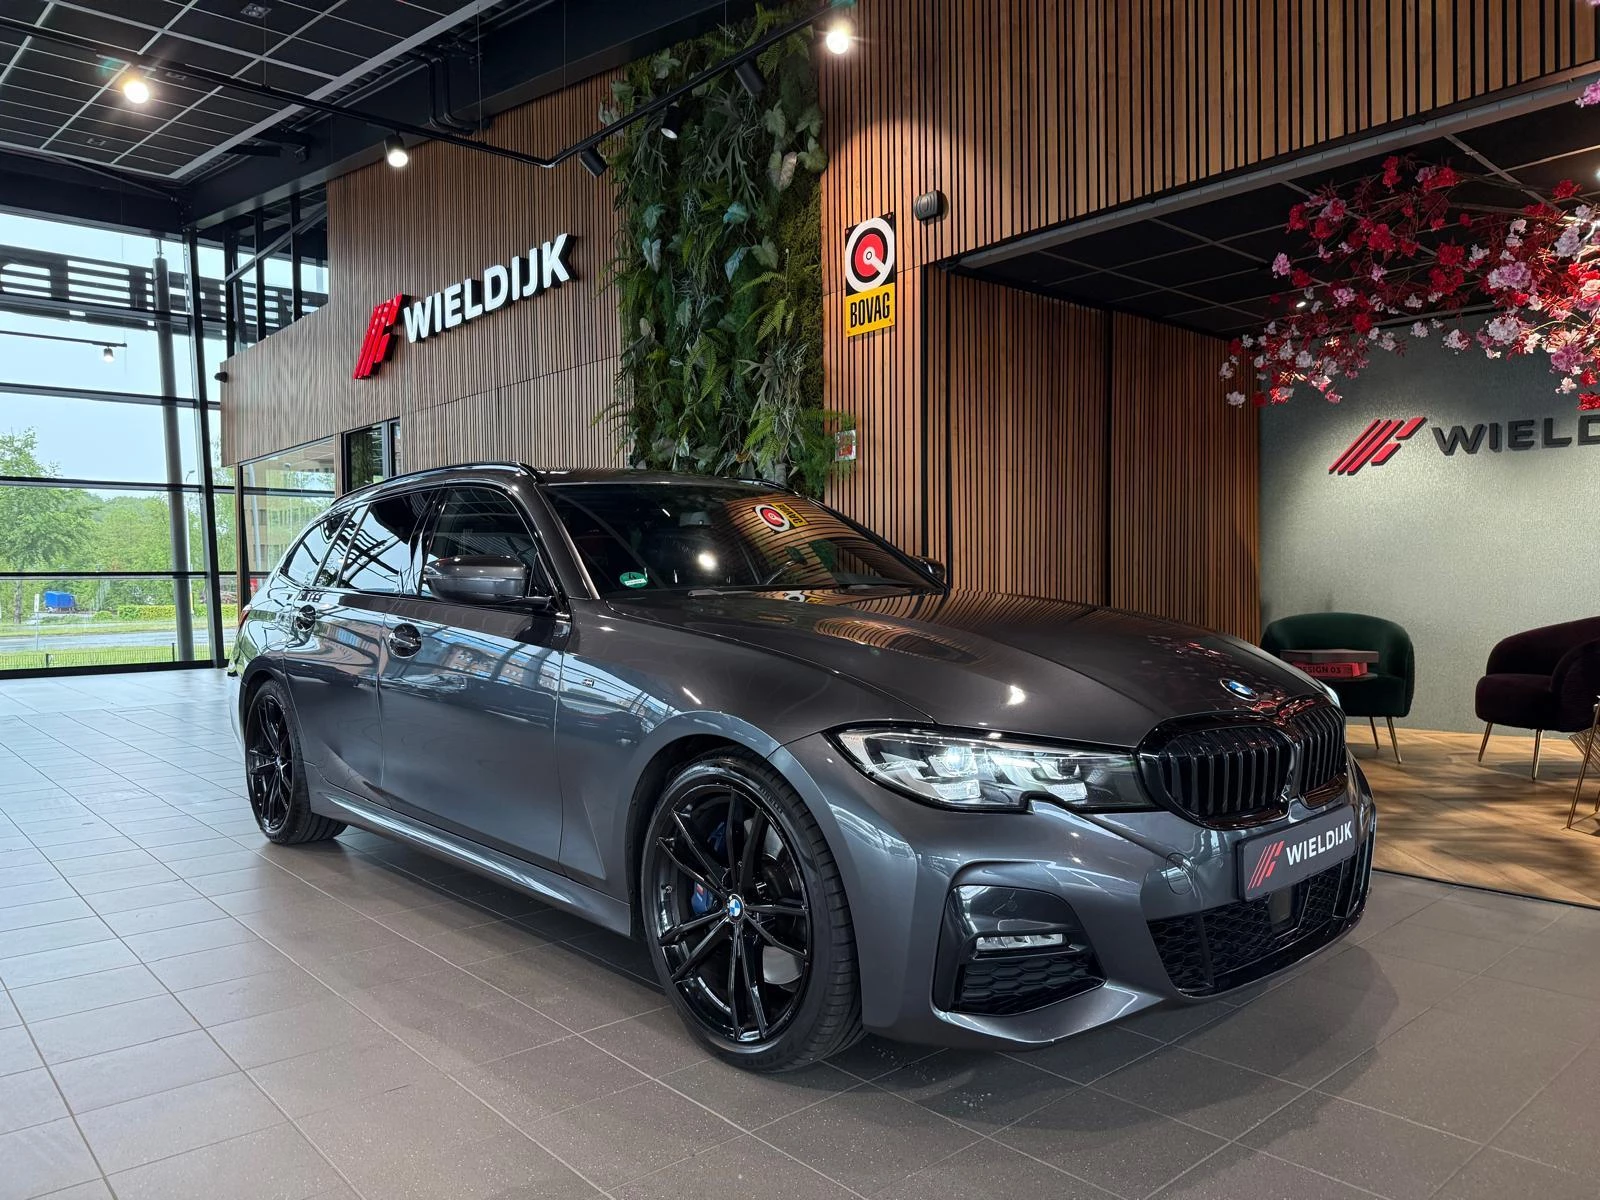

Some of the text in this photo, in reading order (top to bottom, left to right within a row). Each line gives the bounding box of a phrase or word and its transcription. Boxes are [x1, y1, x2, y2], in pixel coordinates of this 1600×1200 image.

[402, 233, 570, 344] WIELDIJK
[850, 291, 890, 328] BOVAG
[1286, 821, 1353, 866] WIELDIJK
